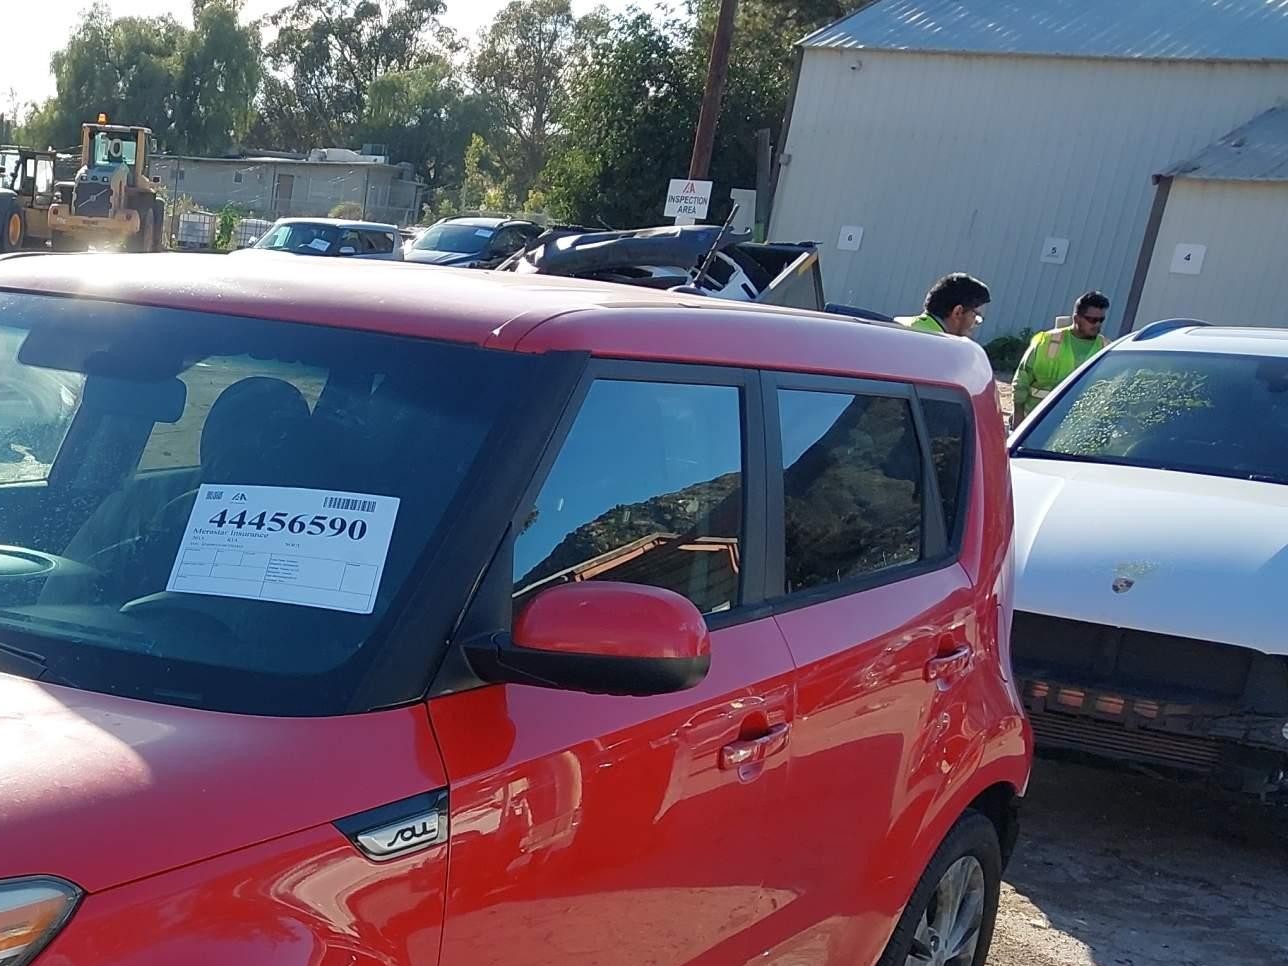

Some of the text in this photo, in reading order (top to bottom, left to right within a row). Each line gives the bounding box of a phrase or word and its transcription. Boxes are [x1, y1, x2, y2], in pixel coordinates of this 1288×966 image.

[668, 195, 708, 205] INSPECTION
[677, 205, 697, 214] AREA
[1183, 252, 1192, 261] 4
[208, 508, 368, 541] 44456590
[230, 529, 269, 539] Insurance
